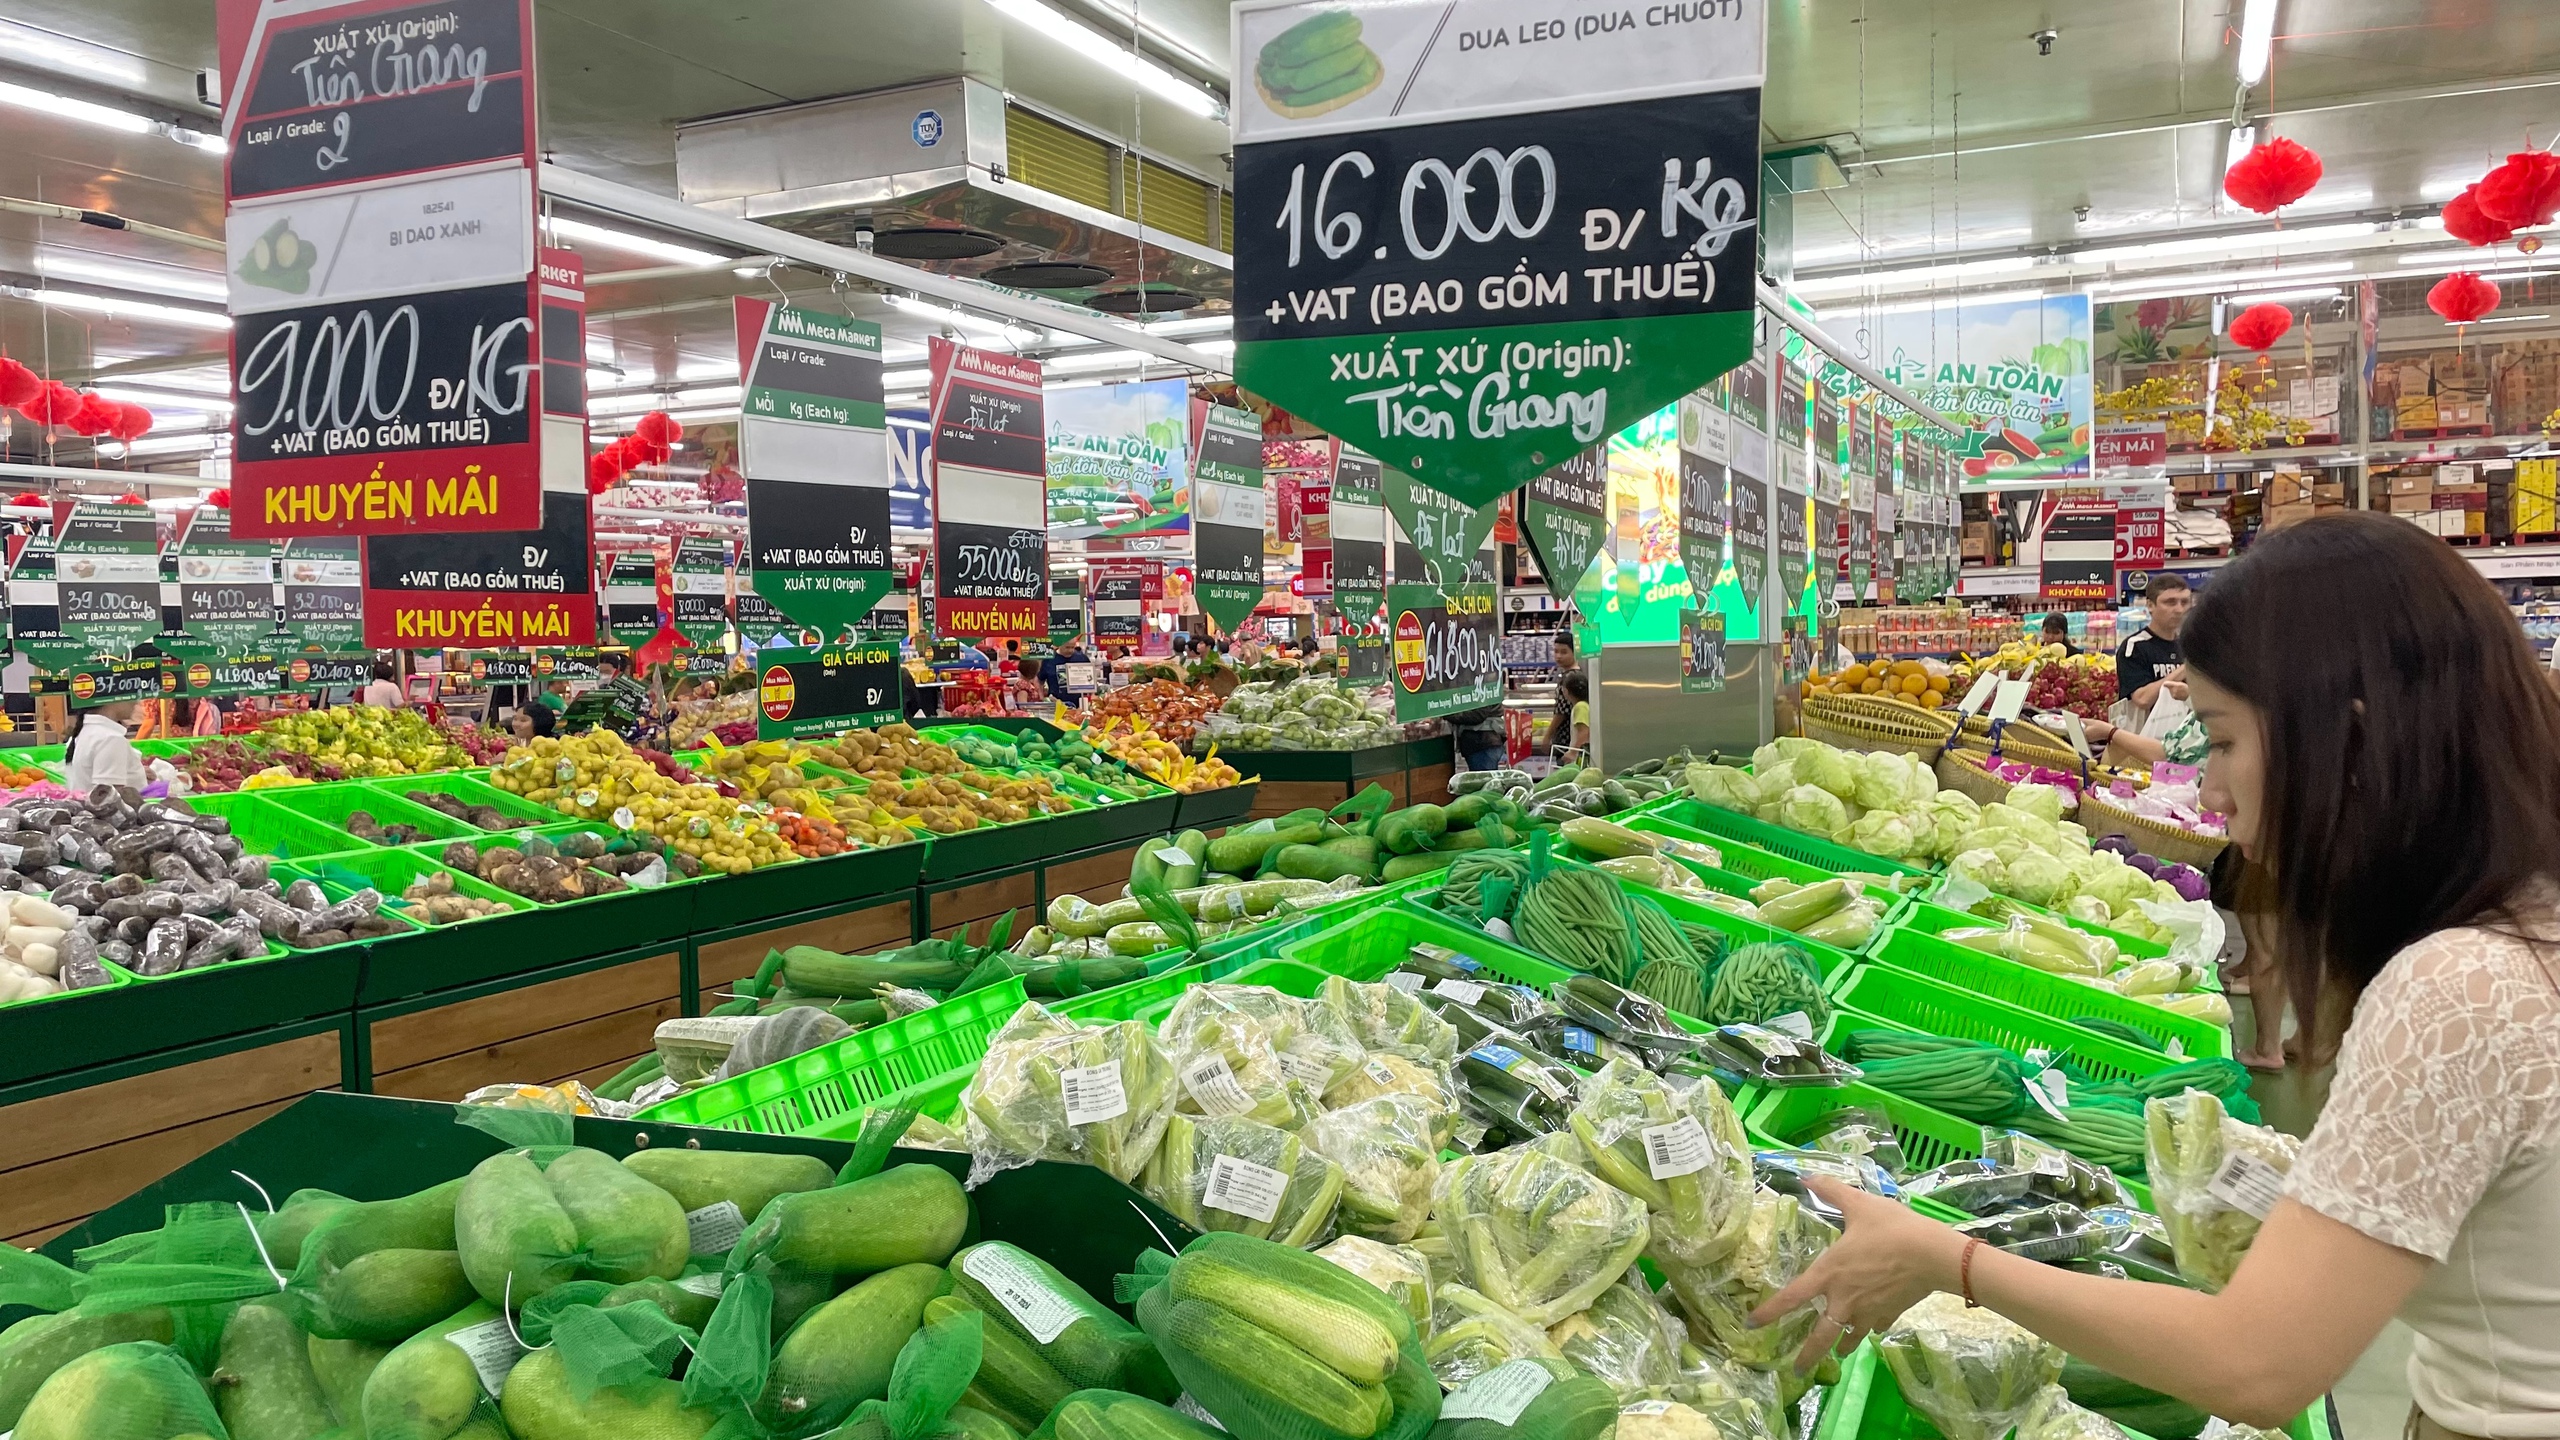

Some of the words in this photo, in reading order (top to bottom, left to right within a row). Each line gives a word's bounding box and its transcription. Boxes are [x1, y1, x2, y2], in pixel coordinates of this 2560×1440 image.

[313, 22, 359, 55] XUẤT
[397, 12, 459, 43] (Origin):
[1519, 19, 1566, 45] LEO
[371, 36, 487, 112] Giang
[247, 124, 272, 146] Loại
[286, 120, 326, 138] Grade:
[317, 112, 350, 171] 2
[423, 202, 455, 215] 182541
[1276, 145, 1556, 268] 16.000
[1580, 208, 1646, 252] Đ/
[1661, 156, 1757, 258] Kg
[390, 231, 402, 248] BI
[406, 226, 435, 246] DAO
[440, 219, 481, 240] XANH
[1265, 286, 1355, 324] +VAT
[1370, 279, 1463, 326] (BAO
[1478, 257, 1568, 309] GỒM
[1584, 243, 1715, 303] THUẾ)
[770, 347, 790, 364] Loại
[799, 352, 827, 366] Grade:
[1330, 335, 1424, 382] XUẤT
[1436, 344, 1488, 376] XỨ
[1501, 336, 1632, 380] (Origin):
[239, 305, 419, 435] 9.000
[428, 378, 466, 411] Đ/
[466, 316, 541, 418] KG
[1936, 364, 1976, 384] AN
[1988, 361, 2063, 398] TOÀN
[755, 391, 775, 412] MỖI
[790, 401, 803, 419] Kg
[805, 404, 831, 419] (Each
[833, 408, 850, 424] kg):
[1346, 379, 1464, 441] Tiền
[1468, 371, 1608, 444] Giang
[1964, 390, 2009, 419] bàn
[2010, 397, 2042, 424] ăn
[271, 430, 317, 454] +VAT
[323, 427, 371, 455] (BAO
[375, 414, 421, 447] GỒM
[427, 408, 490, 444] THUẾ)
[1083, 435, 1109, 453] AN
[1116, 437, 1167, 467] TOÀN
[2125, 437, 2155, 453] MÃI
[1072, 456, 1099, 475] đến
[1102, 458, 1131, 480] bàn
[1132, 467, 1153, 487] ăn
[265, 461, 413, 524] KHUYẾN
[426, 464, 498, 517] MÃI
[1553, 481, 1569, 502] (BAO
[850, 526, 867, 545] Đ/
[2133, 524, 2157, 537] 000
[87, 545, 97, 553] Kg
[98, 545, 117, 553] (Each
[522, 546, 548, 567] Đ/
[763, 549, 791, 564] +VAT
[795, 549, 823, 567] (BAO
[826, 543, 850, 565] GỒM
[852, 544, 884, 567] THUẾ)
[1243, 555, 1252, 568] Đ/
[958, 545, 1021, 581] 55.000
[1201, 569, 1216, 580] +VAT
[1216, 569, 1229, 582] (BAO
[400, 571, 440, 587] +VAT
[444, 572, 482, 591] (BAO
[485, 567, 518, 589] GỒM
[522, 568, 565, 593] THUẾ)
[784, 571, 812, 592] XUẤT
[816, 575, 830, 590] XỨ
[833, 575, 866, 594] (Origin):
[954, 585, 972, 596] +VAT
[974, 585, 993, 598] (BAO
[994, 582, 1010, 598] GỒM
[2048, 586, 2087, 597] KHUYẾN
[2088, 586, 2106, 596] MÃI
[192, 589, 245, 610] 44.000
[1477, 592, 1492, 614] CÒN
[396, 597, 513, 637] KHUYẾN
[522, 604, 571, 637] MÃI
[951, 603, 1008, 631] KHUYẾN
[1012, 608, 1036, 631] MÃI
[823, 650, 842, 668] GIÁ
[845, 650, 863, 666] CHỈ
[867, 650, 889, 664] CÒN
[867, 688, 883, 706] Đ/
